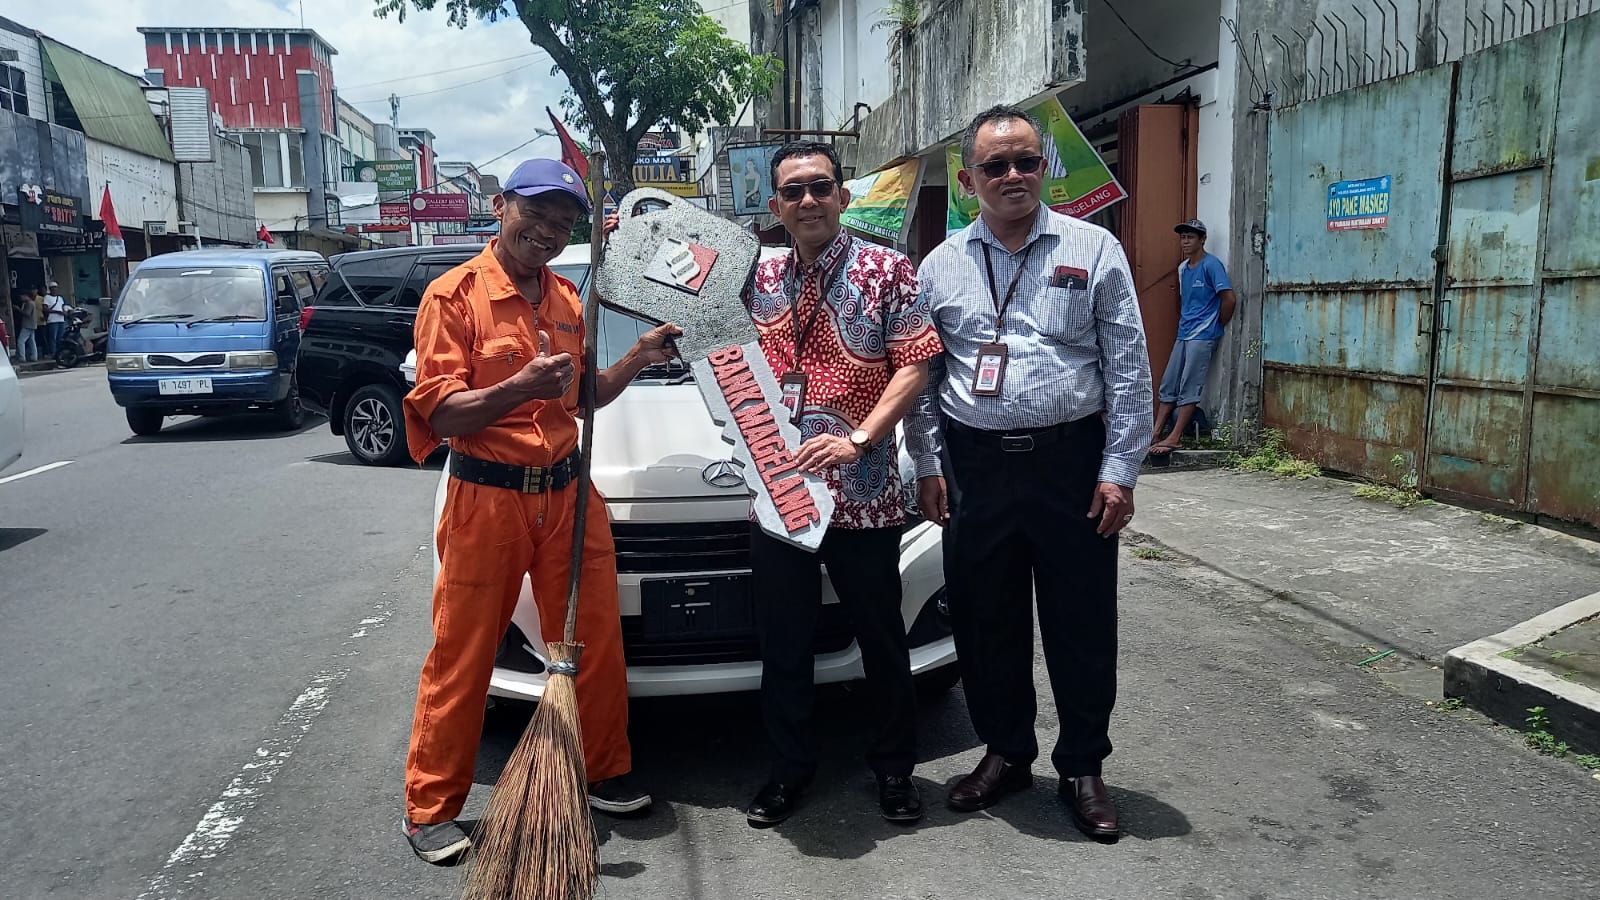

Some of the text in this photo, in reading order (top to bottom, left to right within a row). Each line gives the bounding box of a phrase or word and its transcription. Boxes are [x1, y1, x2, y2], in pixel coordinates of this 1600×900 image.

[1328, 193, 1389, 218] AYO PAKE MASKER
[160, 381, 167, 390] H
[199, 379, 209, 388] PL
[708, 344, 821, 537] BANK MAGELANG
